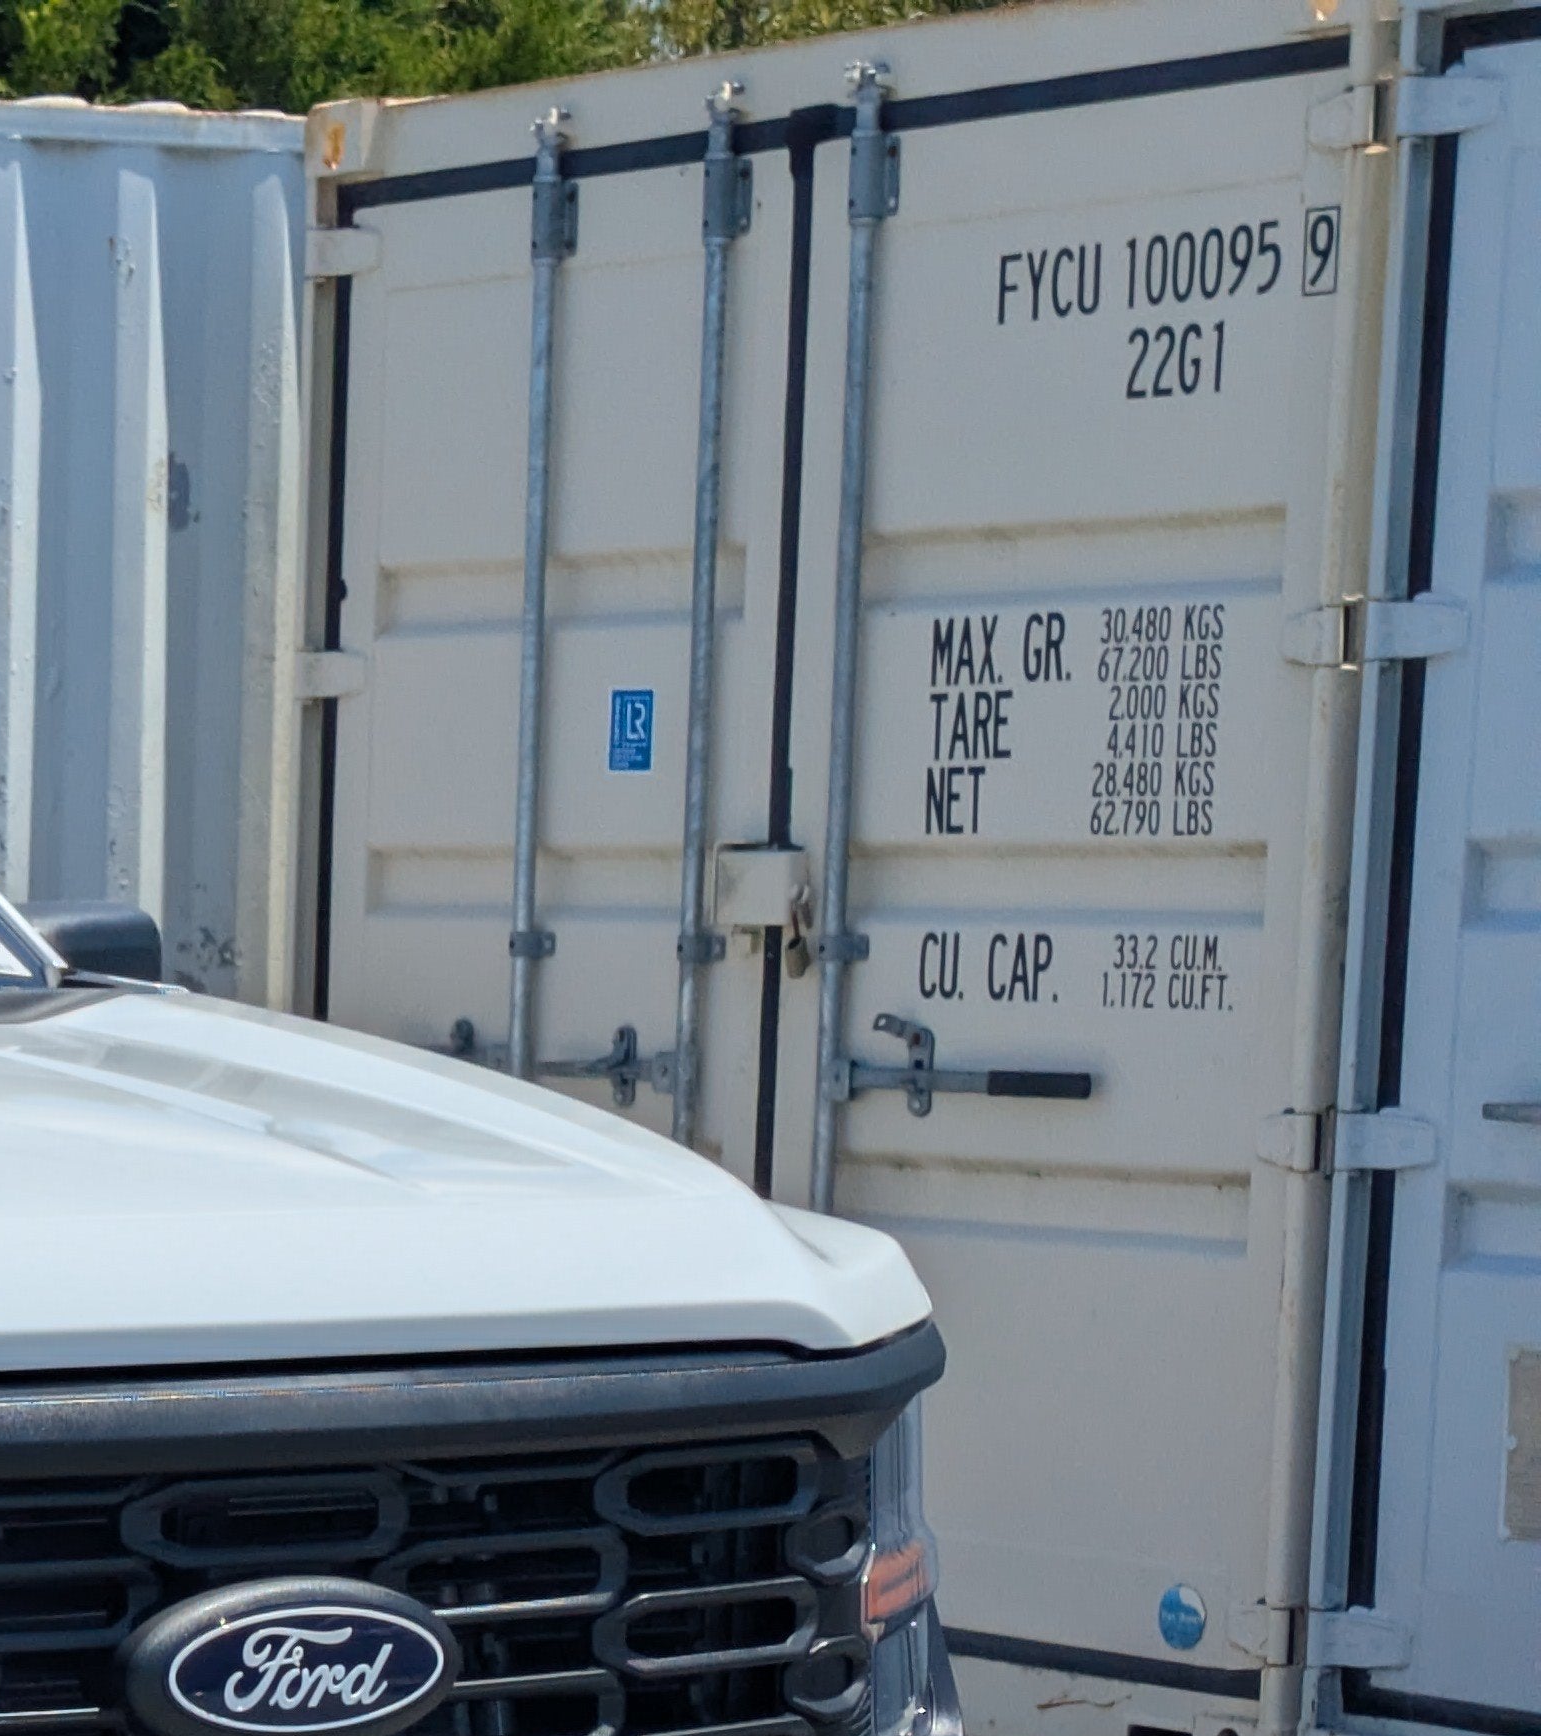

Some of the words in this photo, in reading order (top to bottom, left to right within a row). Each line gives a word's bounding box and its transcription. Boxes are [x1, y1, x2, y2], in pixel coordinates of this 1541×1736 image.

[997, 243, 1102, 326] FYCU
[1126, 219, 1282, 309] 100095
[1308, 213, 1335, 288] 9
[1125, 320, 1225, 400] 22G1
[1100, 606, 1172, 645] 30.480
[1183, 603, 1225, 643] KGS
[930, 614, 1003, 687] MAX.
[1023, 611, 1071, 683] GR.
[1097, 644, 1170, 683] 67.200
[1180, 643, 1223, 681] LBS
[1108, 683, 1168, 722] 2.000
[1178, 682, 1220, 721] KGS
[929, 689, 1014, 761] TARE
[1106, 722, 1165, 759] 4.410
[1176, 721, 1218, 759] LBS
[1091, 760, 1163, 798] 28.480
[1174, 759, 1216, 798] KGS
[925, 765, 986, 835] NET
[1089, 799, 1161, 837] 62.790
[1172, 799, 1214, 837] LBS
[918, 931, 964, 1000] CU.
[987, 932, 1058, 1003] CAP.
[1112, 933, 1159, 971] 33.2
[1170, 934, 1222, 972] CU.M.
[1102, 972, 1157, 1009] 1.172
[1167, 972, 1233, 1011] CU.FT.
[223, 1626, 393, 1713] Ford
